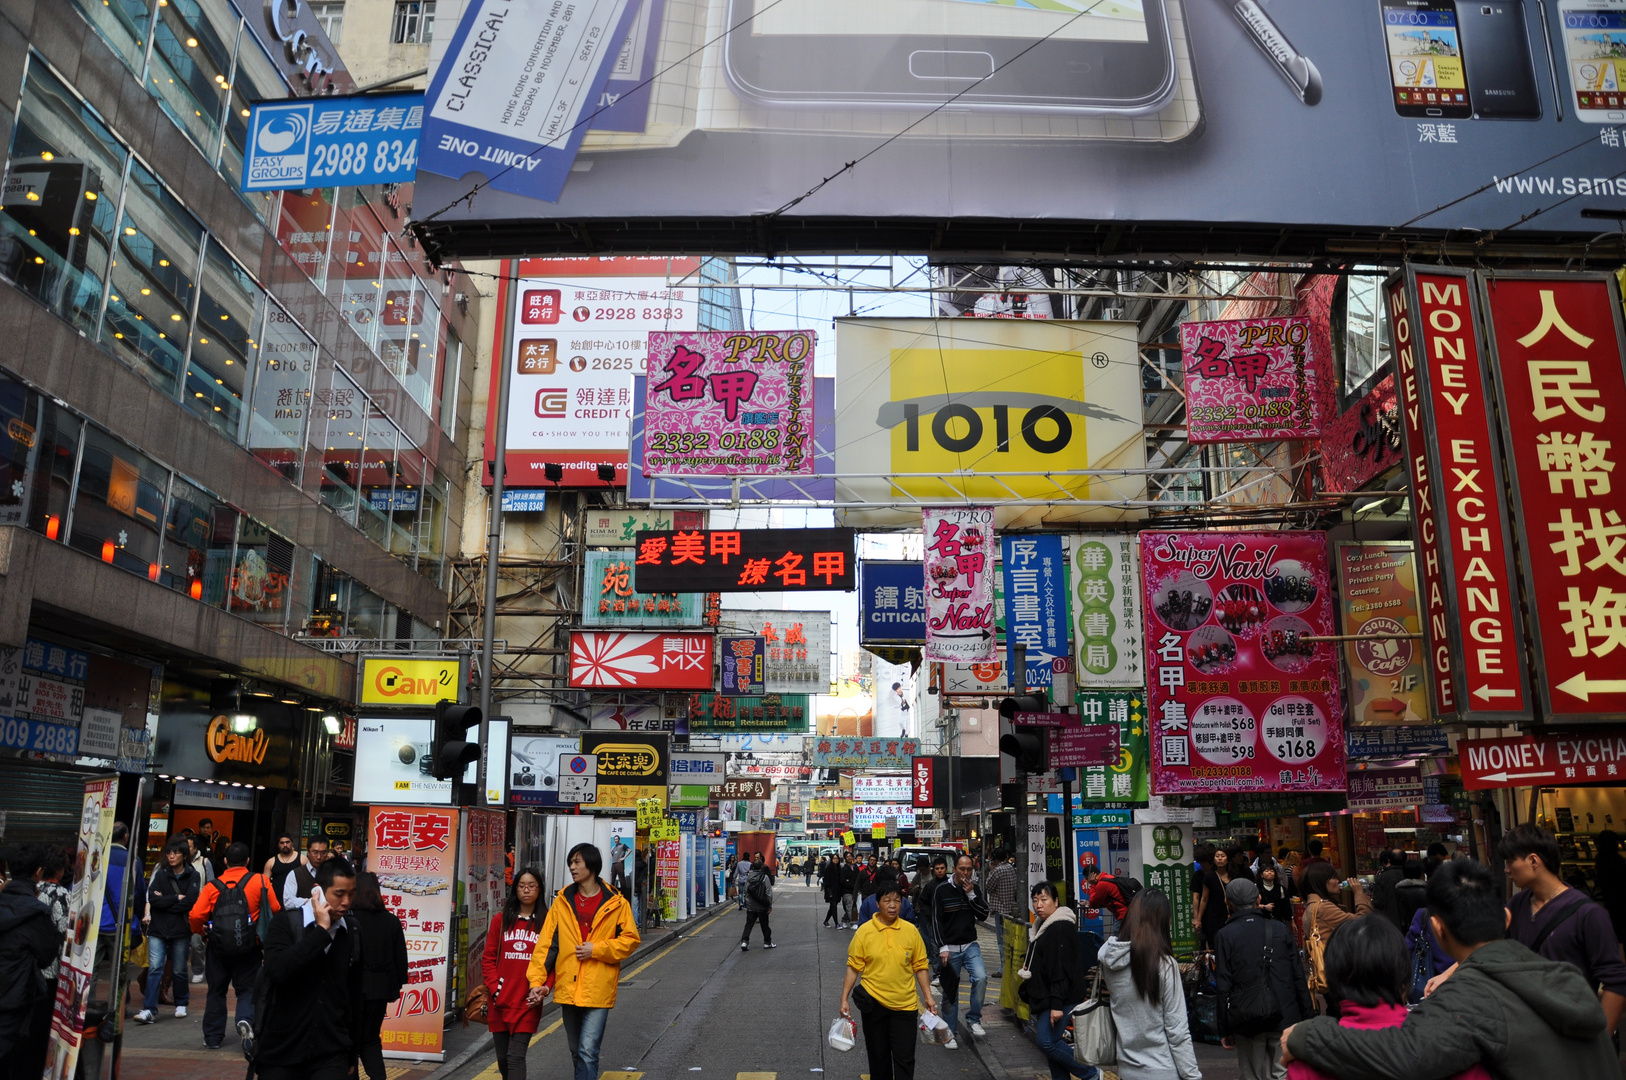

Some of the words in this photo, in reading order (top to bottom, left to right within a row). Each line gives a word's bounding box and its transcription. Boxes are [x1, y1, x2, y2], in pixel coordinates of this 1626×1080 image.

[1387, 12, 1428, 25] 07:00
[1567, 15, 1608, 28] 07:00
[447, 12, 508, 111] CLASSICAL
[514, 87, 538, 127] TUESDAY,
[542, 25, 569, 71] NOVEMBER,
[562, 5, 576, 22] 2011
[618, 47, 631, 70] HALL
[501, 97, 518, 124] HONG
[513, 70, 530, 97] KONG
[523, 23, 552, 72] CONVENTION
[547, 111, 563, 136] HALL
[559, 100, 568, 111] 3F
[580, 38, 595, 61] SEAT
[590, 26, 600, 38] 23
[313, 105, 424, 136] 易通集團
[1417, 124, 1458, 144] 深藍
[438, 134, 478, 157] ONE
[252, 156, 284, 168] EASY
[310, 142, 368, 177] 2988
[480, 147, 541, 172] ADMIT
[251, 166, 304, 180] GROUPS
[530, 295, 553, 306] 旺角
[529, 308, 553, 319] 分行
[595, 308, 636, 320] 2928
[642, 308, 683, 320] 8383
[1239, 324, 1308, 349] PRO
[526, 345, 550, 356] 太子
[724, 335, 810, 362] PRO
[525, 357, 549, 369] 分行
[592, 358, 633, 370] 2625
[1188, 337, 1270, 394] 名甲
[654, 345, 759, 422] 名甲
[575, 409, 621, 419] CREDIT
[741, 412, 779, 425] 旗艦店
[1191, 406, 1237, 422] 2332
[1245, 401, 1292, 418] 0188
[904, 403, 1073, 454] 1010
[652, 432, 710, 453] 2332
[719, 429, 780, 449] 0188
[650, 453, 780, 468] www.supernail.com.hk
[1422, 282, 1470, 416] MONEY
[1451, 439, 1504, 674] EXCHANGE
[1516, 290, 1626, 658] 人民幣找換
[1392, 287, 1420, 431] MONEY
[1415, 455, 1453, 706] EXCHANGE
[953, 511, 991, 524] PRO
[635, 530, 741, 565] 愛美甲
[929, 519, 985, 588] 名甲
[1155, 535, 1216, 568] Super
[1193, 543, 1279, 580] Nail
[1348, 566, 1361, 574] Tea
[1361, 564, 1373, 572] Set
[1382, 560, 1405, 569] Dinner
[1120, 541, 1134, 629] 買賣中學新舊課本
[1349, 576, 1374, 585] Private
[1375, 573, 1394, 583] Party
[932, 581, 971, 602] Super
[1010, 539, 1043, 650] 序言書室
[1350, 586, 1380, 597] Catering
[1082, 547, 1110, 669] 華英書局
[1366, 602, 1383, 610] 2380
[1384, 599, 1401, 608] 6588
[930, 603, 992, 630] Nail
[663, 638, 706, 653] 美心
[25, 642, 87, 678] 德興行
[663, 655, 705, 670] MX
[1367, 657, 1407, 671] Café
[1187, 681, 1230, 694] 環境舒適
[1390, 674, 1416, 693] 2/F
[1157, 631, 1190, 766] 名甲集團
[1270, 704, 1285, 716] Gel
[714, 719, 736, 728] Lung
[1231, 717, 1255, 731] $68
[34, 724, 77, 754] 2883
[1350, 729, 1413, 746] 序言書室
[818, 740, 917, 756] 維珍尼亞賓館
[1231, 746, 1255, 759] $98
[1278, 740, 1316, 759] $168
[827, 757, 869, 766] VIRGINIA
[875, 757, 908, 766] HOTEL
[1468, 743, 1545, 771] MONEY
[765, 766, 782, 774] 699
[1230, 767, 1252, 776] 0188
[583, 778, 589, 787] 7
[583, 793, 594, 802] 12
[374, 811, 451, 851] 德安
[1031, 842, 1044, 854] Orly
[1046, 836, 1061, 849] $60
[379, 855, 440, 872] 駕駛學校
[503, 929, 540, 943] HAROLDS
